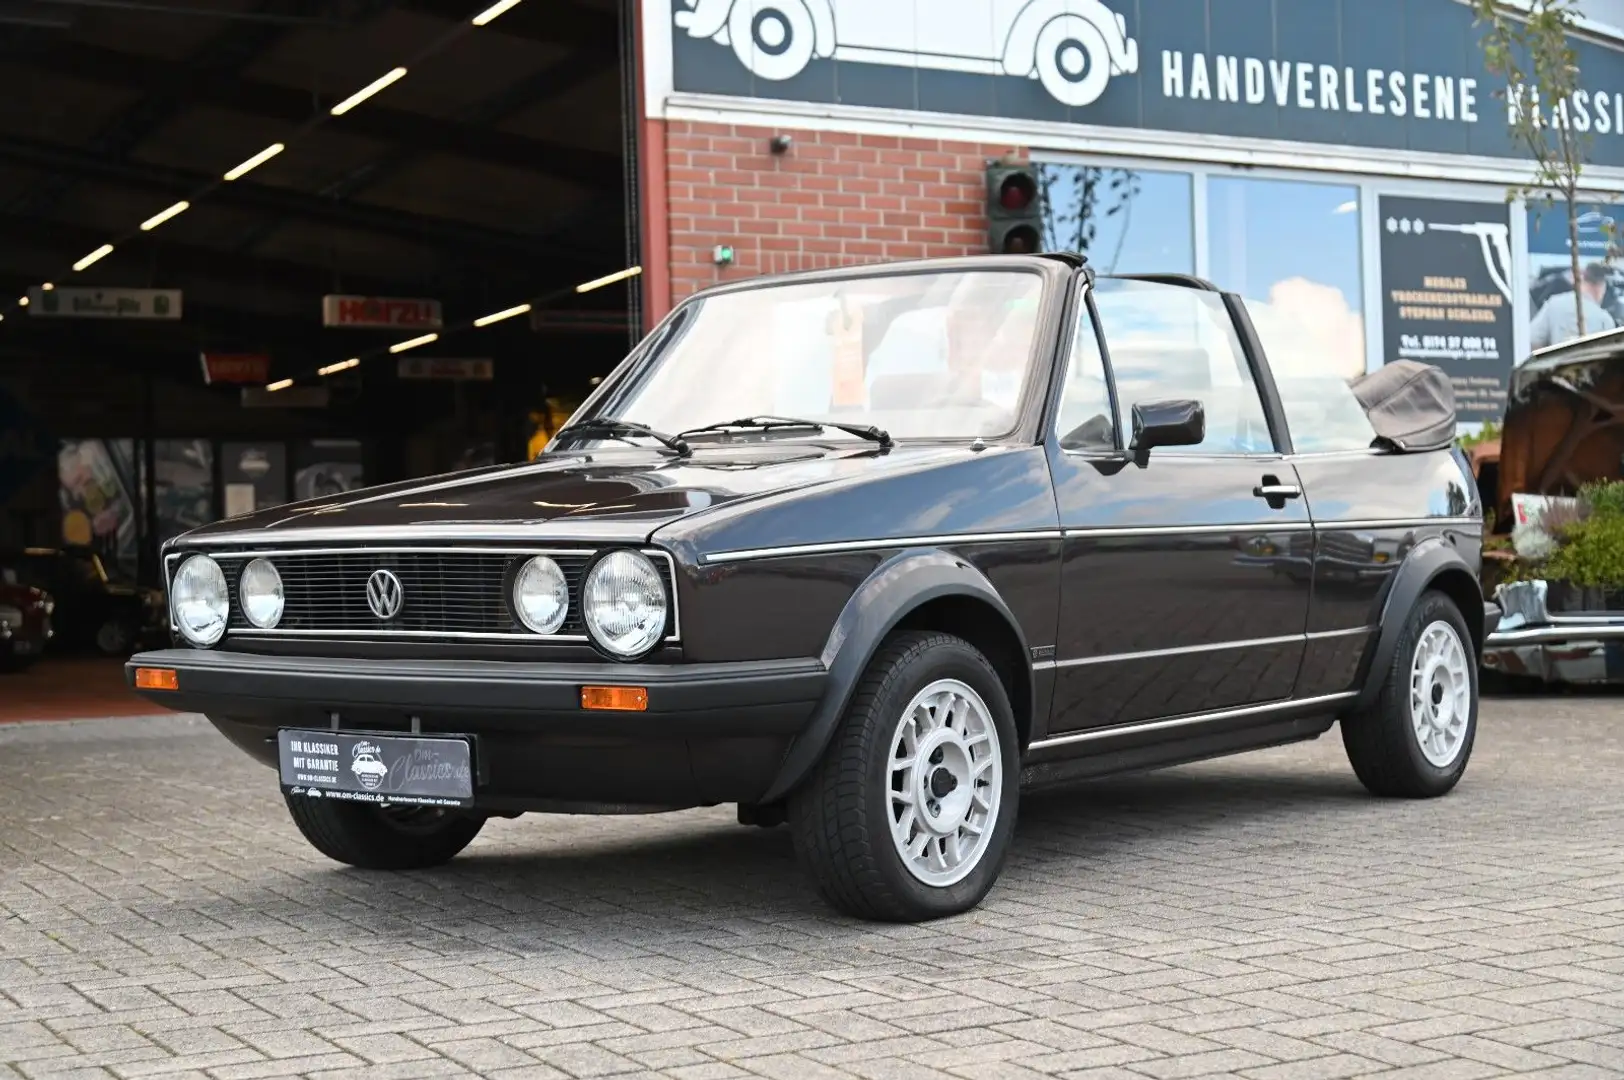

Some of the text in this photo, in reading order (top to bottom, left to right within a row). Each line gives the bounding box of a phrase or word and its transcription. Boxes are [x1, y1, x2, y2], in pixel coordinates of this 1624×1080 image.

[1162, 49, 1478, 122] HANDVERLESENE
[291, 740, 340, 756] IHR KLASSIKER
[293, 757, 340, 772] MIT GARANTIE
[325, 790, 385, 803] www.om-classics.de
